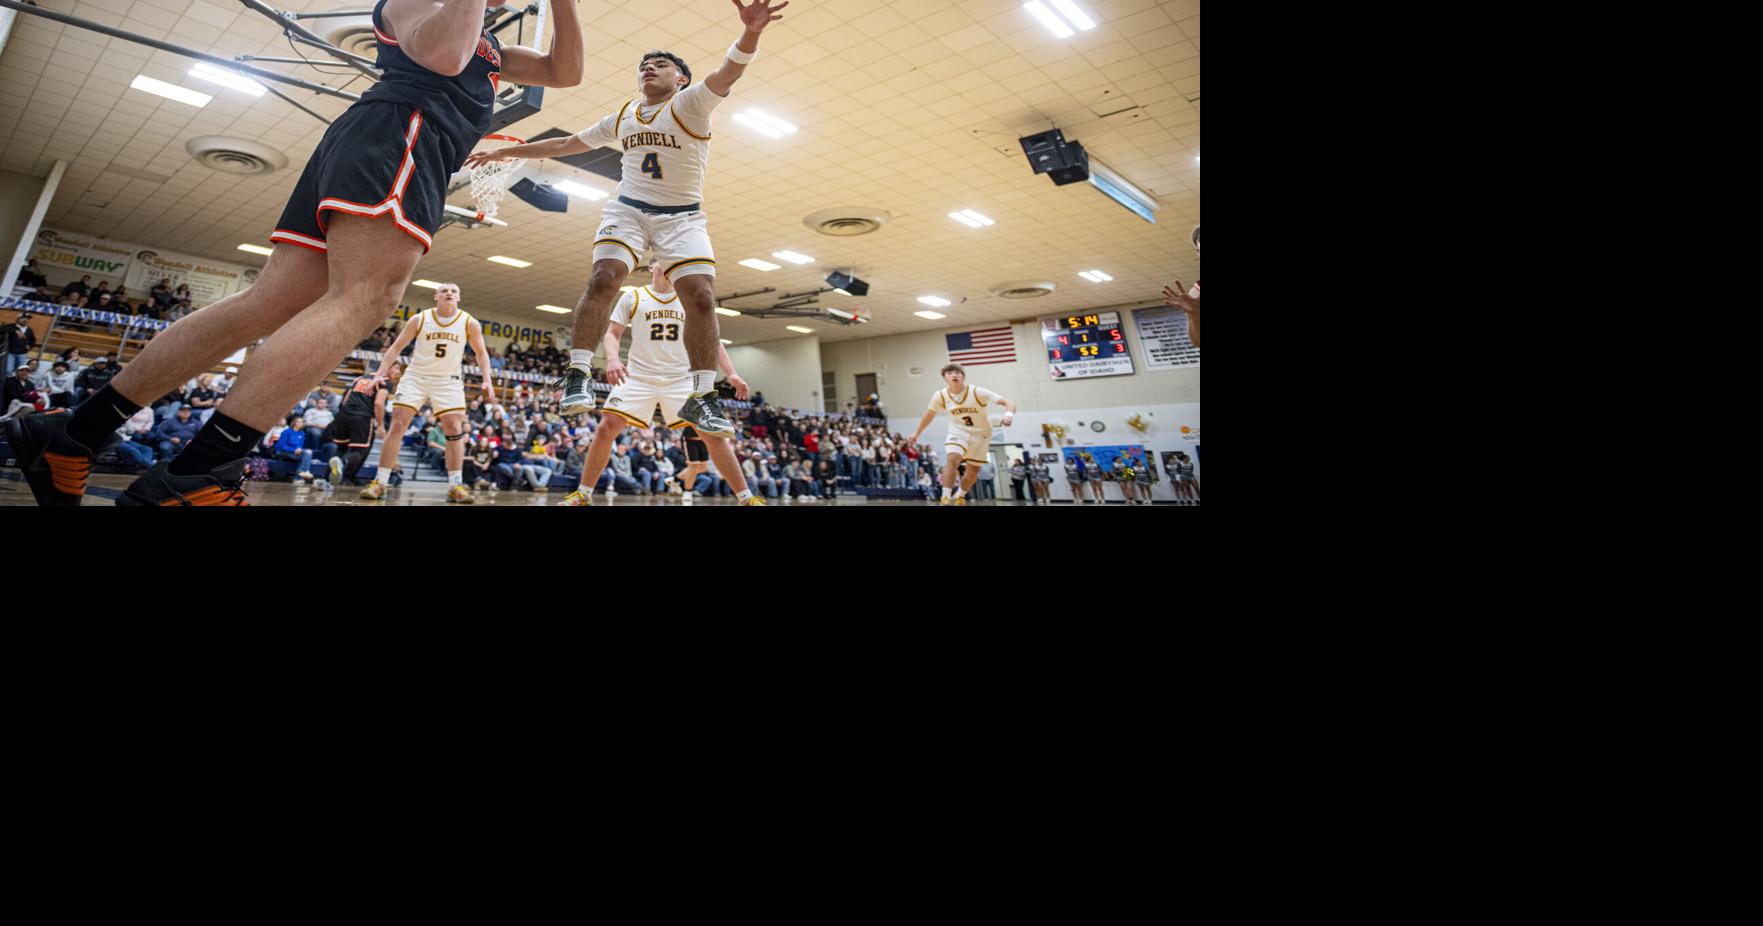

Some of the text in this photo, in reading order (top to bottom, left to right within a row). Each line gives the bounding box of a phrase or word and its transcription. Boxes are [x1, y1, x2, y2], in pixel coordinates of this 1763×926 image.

[621, 131, 682, 151] WENDELL
[641, 152, 663, 179] 4
[37, 249, 125, 273] SUBWAY
[645, 309, 685, 322] WENDELL
[1068, 315, 1099, 328] 5:14
[425, 331, 460, 343] WENDELL
[478, 319, 553, 345] TROJANS
[650, 323, 679, 341] 23
[1081, 334, 1088, 342] 1
[1110, 329, 1122, 341] 5
[1057, 335, 1069, 346] 4
[435, 343, 448, 358] 5
[1053, 349, 1061, 359] 3
[1115, 343, 1125, 353] 3
[1061, 361, 1088, 369] UNITED
[1078, 367, 1115, 376] OF IDAHO
[962, 416, 974, 426] 3
